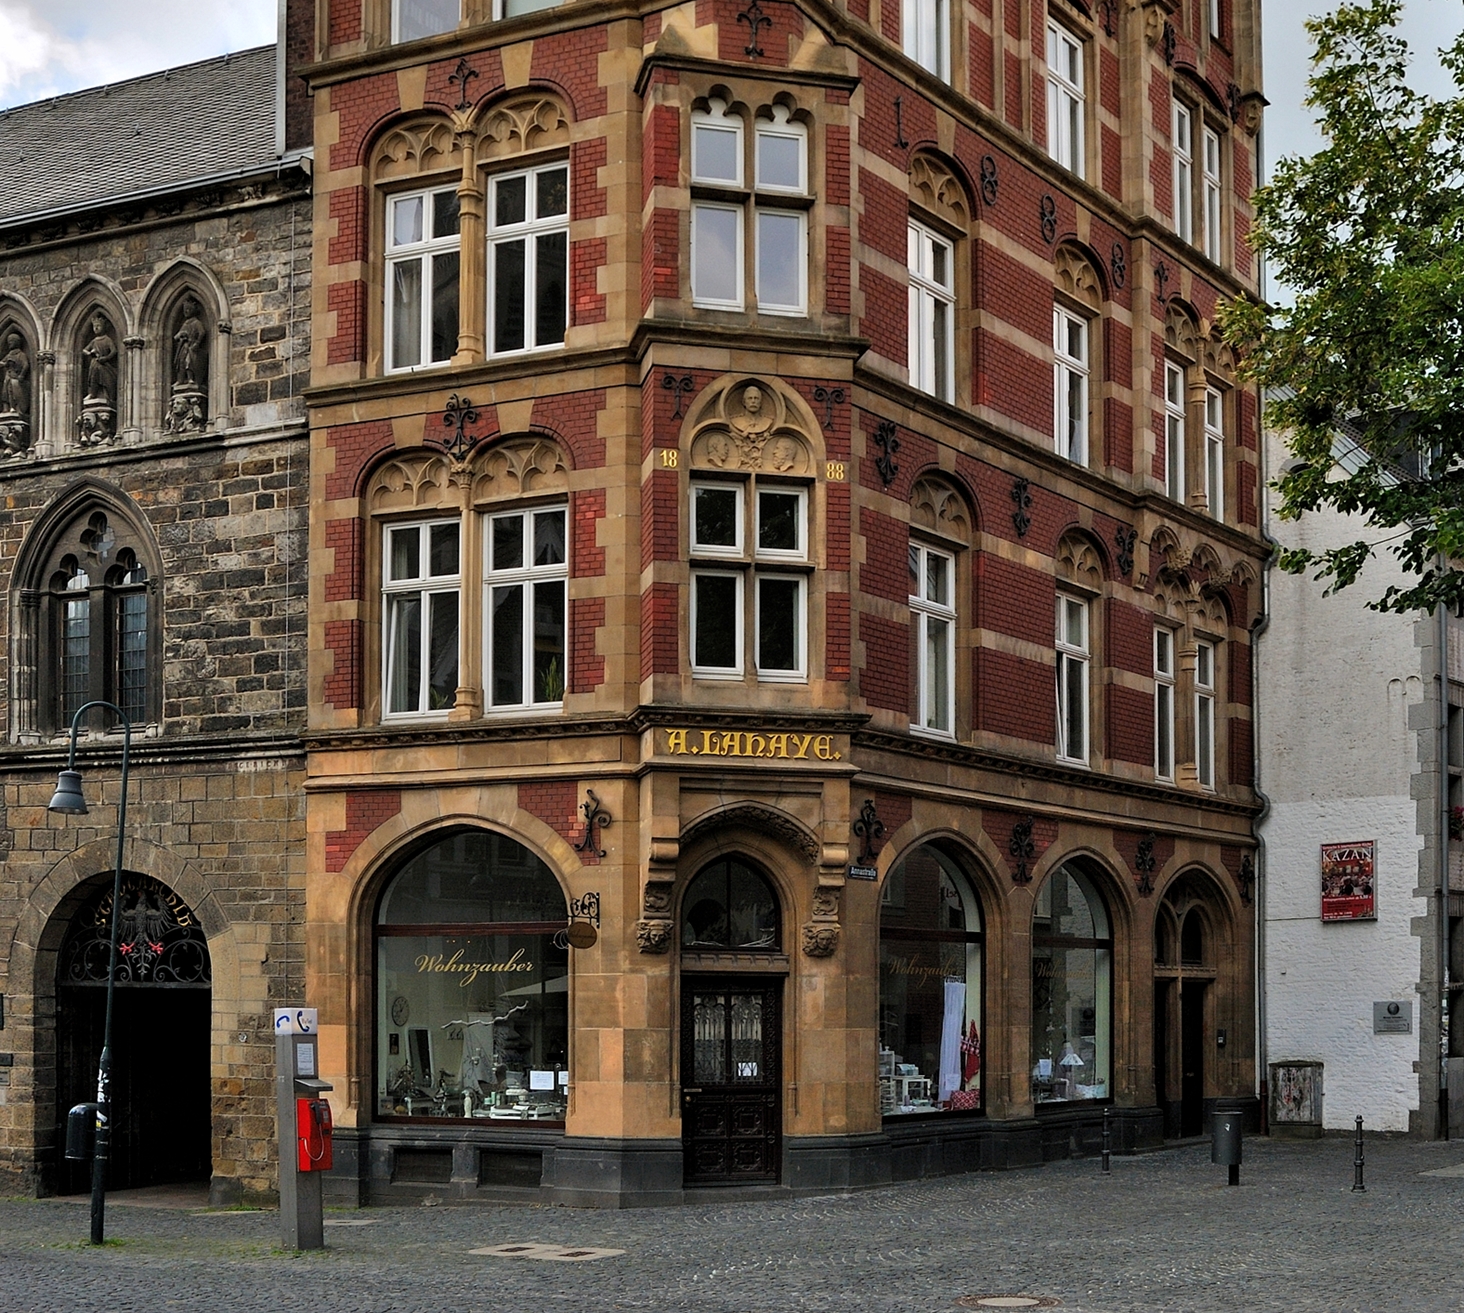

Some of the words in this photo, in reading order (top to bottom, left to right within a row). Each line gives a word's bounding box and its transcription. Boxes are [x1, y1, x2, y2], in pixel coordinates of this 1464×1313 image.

[660, 449, 679, 468] 18
[826, 462, 844, 481] 88
[1322, 847, 1373, 862] KAZAN
[414, 948, 534, 988] Wohnzauber
